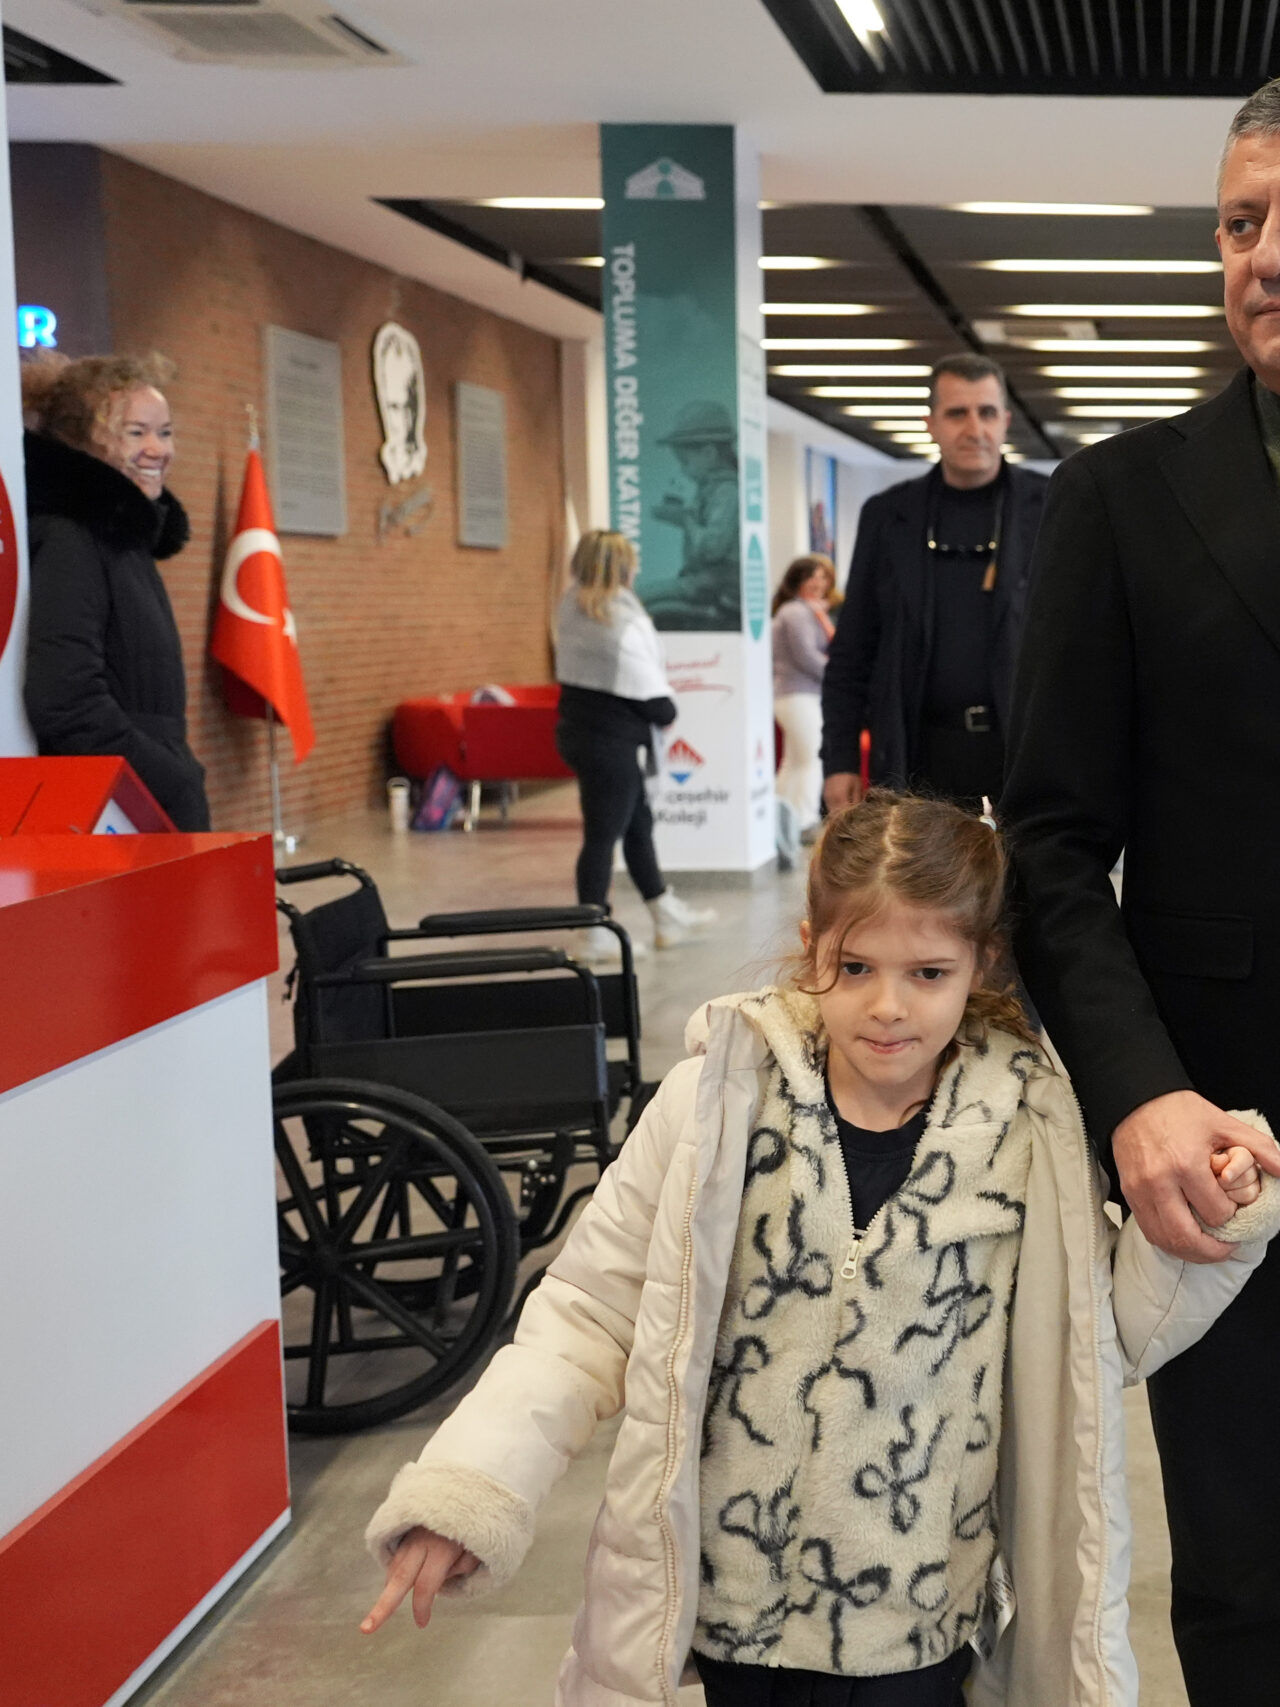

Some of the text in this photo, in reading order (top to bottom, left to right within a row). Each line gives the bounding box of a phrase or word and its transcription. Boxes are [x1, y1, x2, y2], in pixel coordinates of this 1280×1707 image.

[612, 242, 643, 573] TOPLUMA DEĞER KATM
